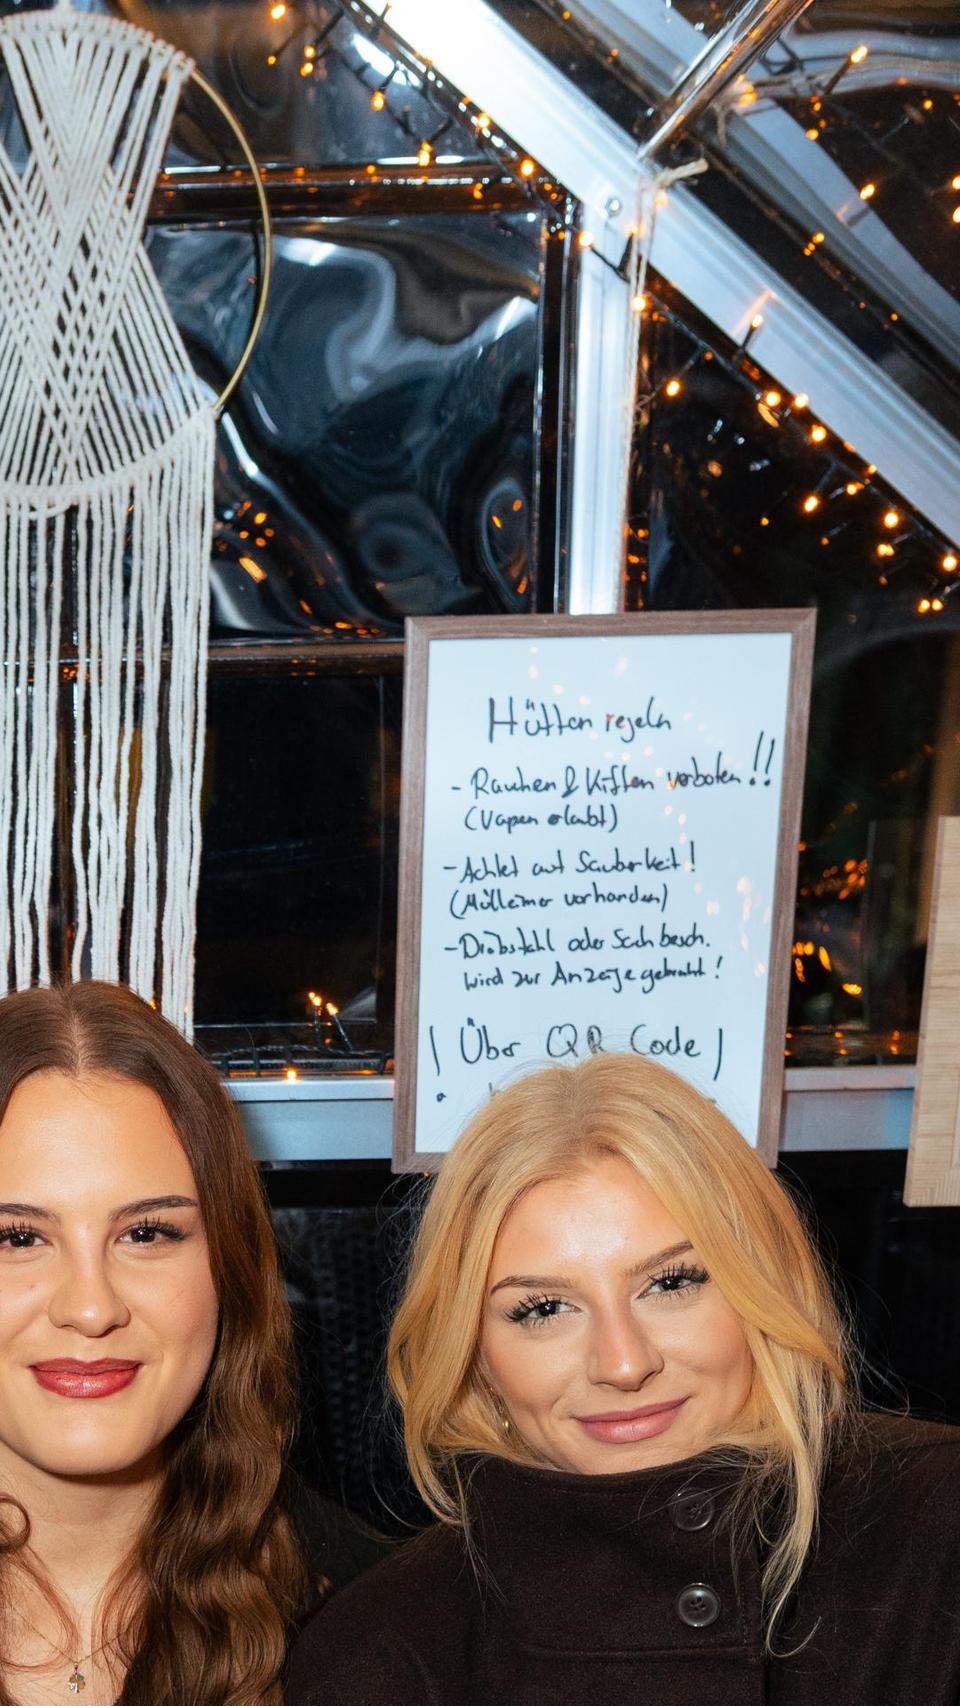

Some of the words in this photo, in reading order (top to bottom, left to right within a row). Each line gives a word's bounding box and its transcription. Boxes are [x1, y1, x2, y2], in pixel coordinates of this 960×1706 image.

[488, 696, 593, 744] Hütten
[604, 696, 672, 744] regeln
[464, 805, 539, 835] (Vapen
[547, 803, 619, 833] erlaubt)
[450, 889, 554, 920] (Mülleimer
[564, 881, 669, 913] vorhanden)
[567, 926, 605, 951] oder
[511, 968, 541, 989] zur
[460, 1016, 521, 1064] Über
[546, 1023, 607, 1058] QR
[629, 1023, 702, 1057] Code
